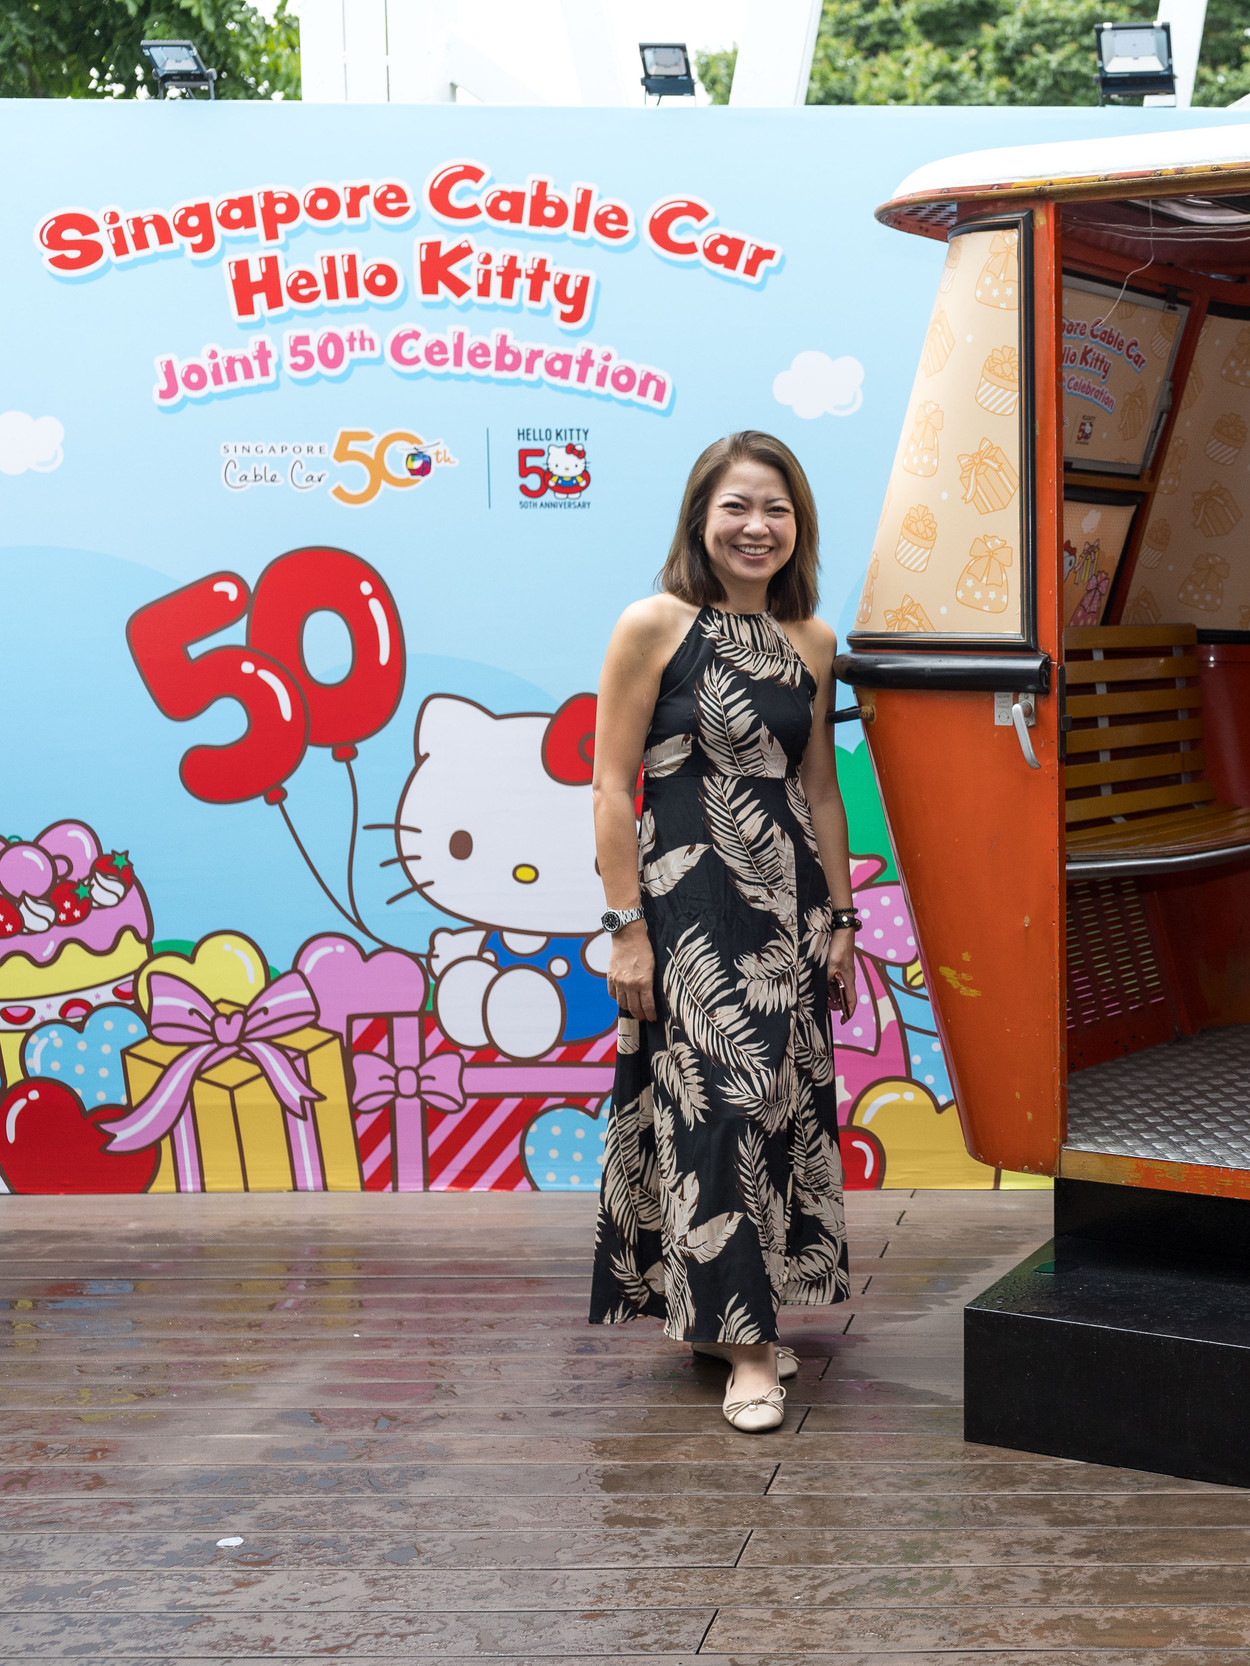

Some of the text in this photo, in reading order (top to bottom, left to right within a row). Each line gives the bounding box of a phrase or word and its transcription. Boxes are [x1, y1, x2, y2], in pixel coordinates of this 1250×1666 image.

[40, 164, 777, 279] Singapore Cable Car
[227, 238, 591, 324] Hello Kitty
[1089, 318, 1124, 352] Cable
[1125, 339, 1147, 370] Car
[158, 328, 668, 404] Joint 50th Celebration
[1080, 345, 1112, 380] Kitty
[1066, 375, 1115, 411] Celebration
[222, 444, 327, 455] SINGAPORE
[517, 427, 590, 441] HELLO KITTY
[223, 458, 327, 490] Cable Car
[519, 500, 592, 510] 50TH ANNIVERSARY
[125, 546, 407, 806] 50
